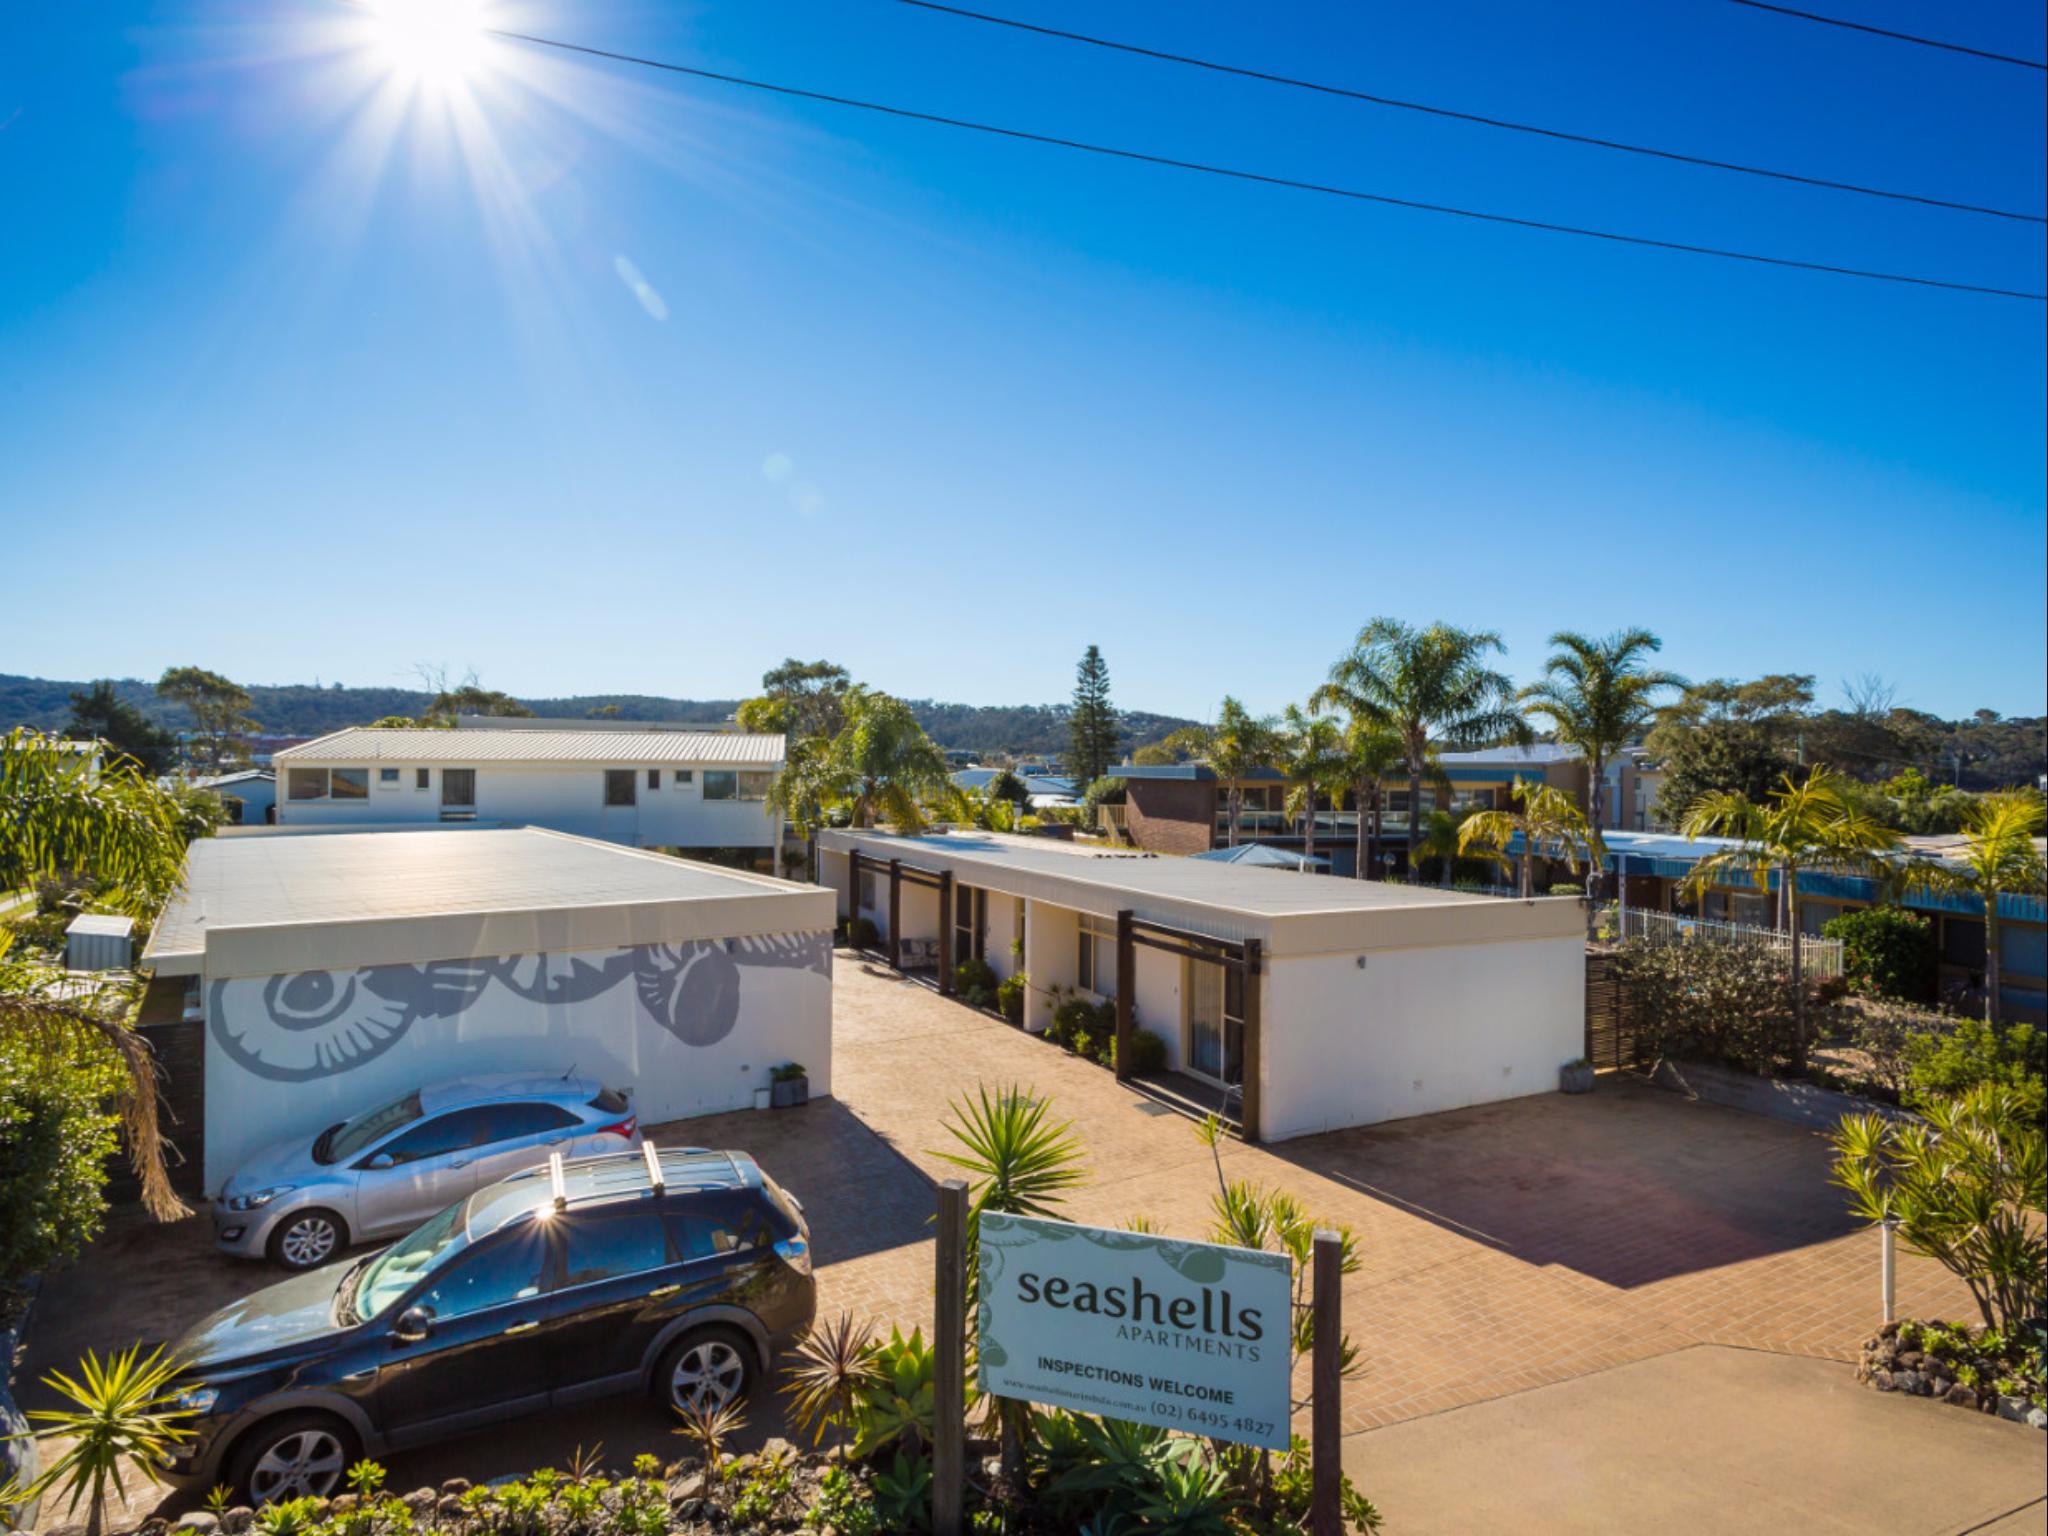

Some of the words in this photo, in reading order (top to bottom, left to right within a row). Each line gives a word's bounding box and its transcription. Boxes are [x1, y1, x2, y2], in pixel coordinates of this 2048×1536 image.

[1017, 1272, 1263, 1341] seashells
[1117, 1324, 1261, 1362] APARTMENTS
[1038, 1357, 1143, 1388] INSPECTIONS
[1149, 1377, 1234, 1404] WELCOME
[1151, 1401, 1182, 1421] (02)
[1188, 1408, 1228, 1429] 6495
[1233, 1418, 1275, 1437] 4827
